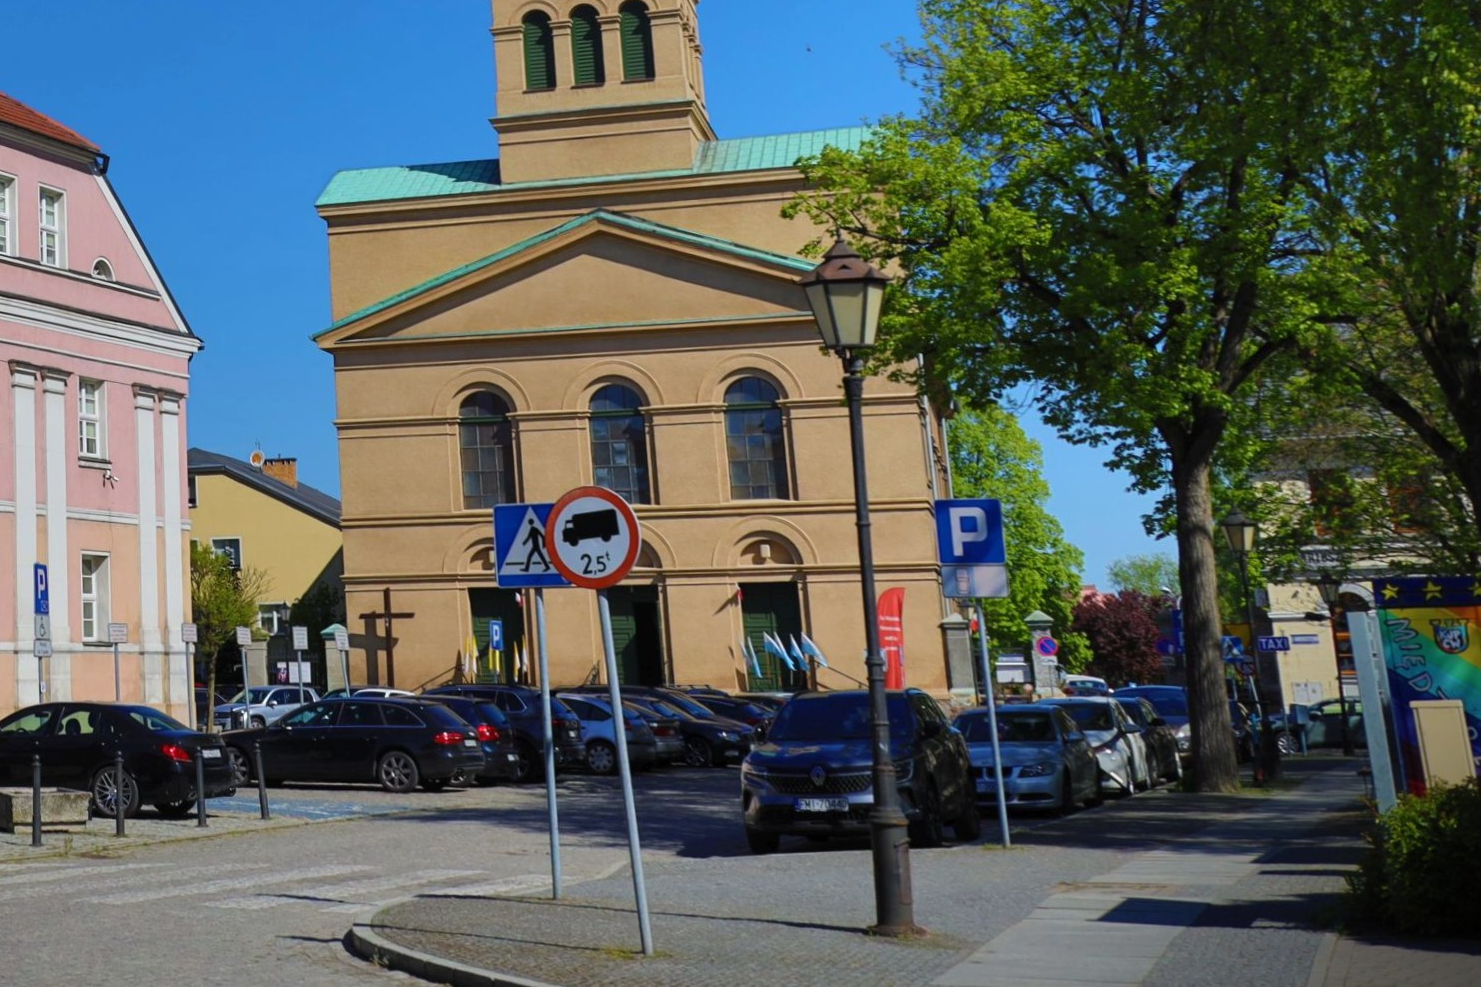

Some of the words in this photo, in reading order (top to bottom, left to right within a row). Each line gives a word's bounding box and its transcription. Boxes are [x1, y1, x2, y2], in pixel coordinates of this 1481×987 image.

[949, 506, 988, 557] P
[37, 568, 46, 599] P
[493, 624, 500, 646] P
[1259, 638, 1288, 650] TAXI
